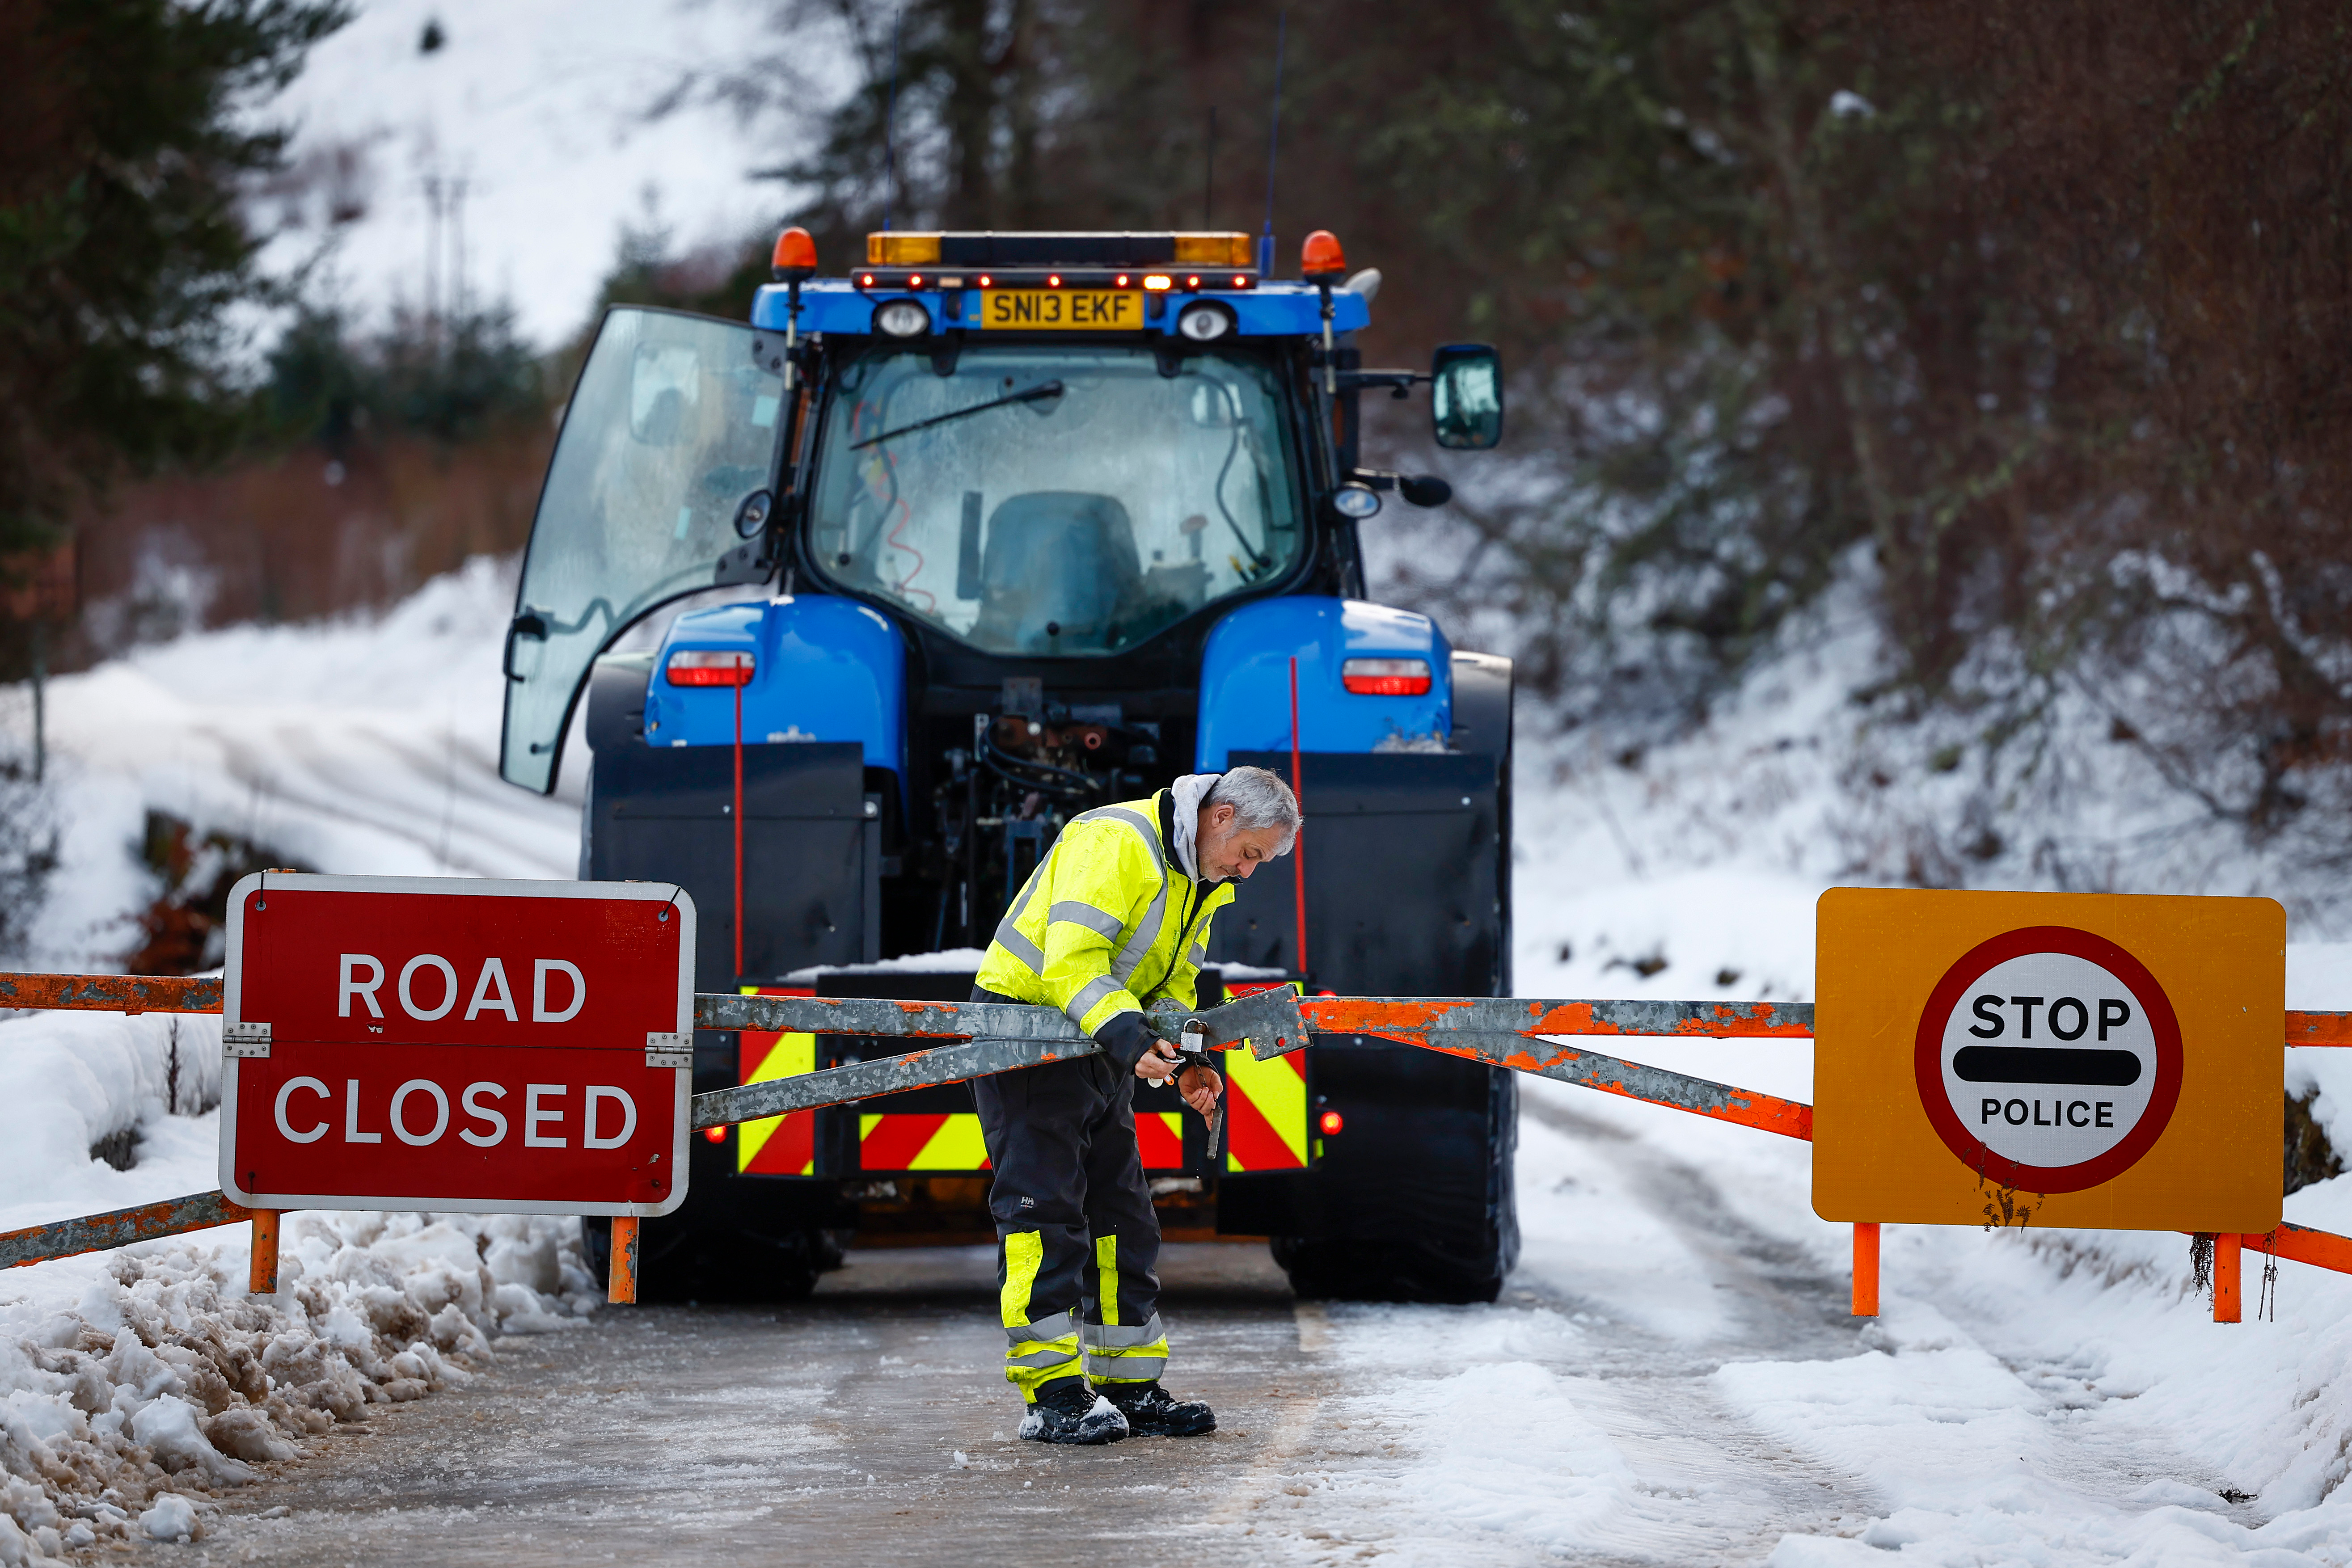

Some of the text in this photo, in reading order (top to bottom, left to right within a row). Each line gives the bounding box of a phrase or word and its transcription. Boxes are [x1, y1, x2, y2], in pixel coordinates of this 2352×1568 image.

[994, 295, 1130, 322] SN13 EKF
[338, 953, 586, 1023] ROAD
[1968, 994, 2131, 1041] STOP
[274, 1076, 637, 1149] CLOSED
[1981, 1098, 2114, 1128] POLICE
